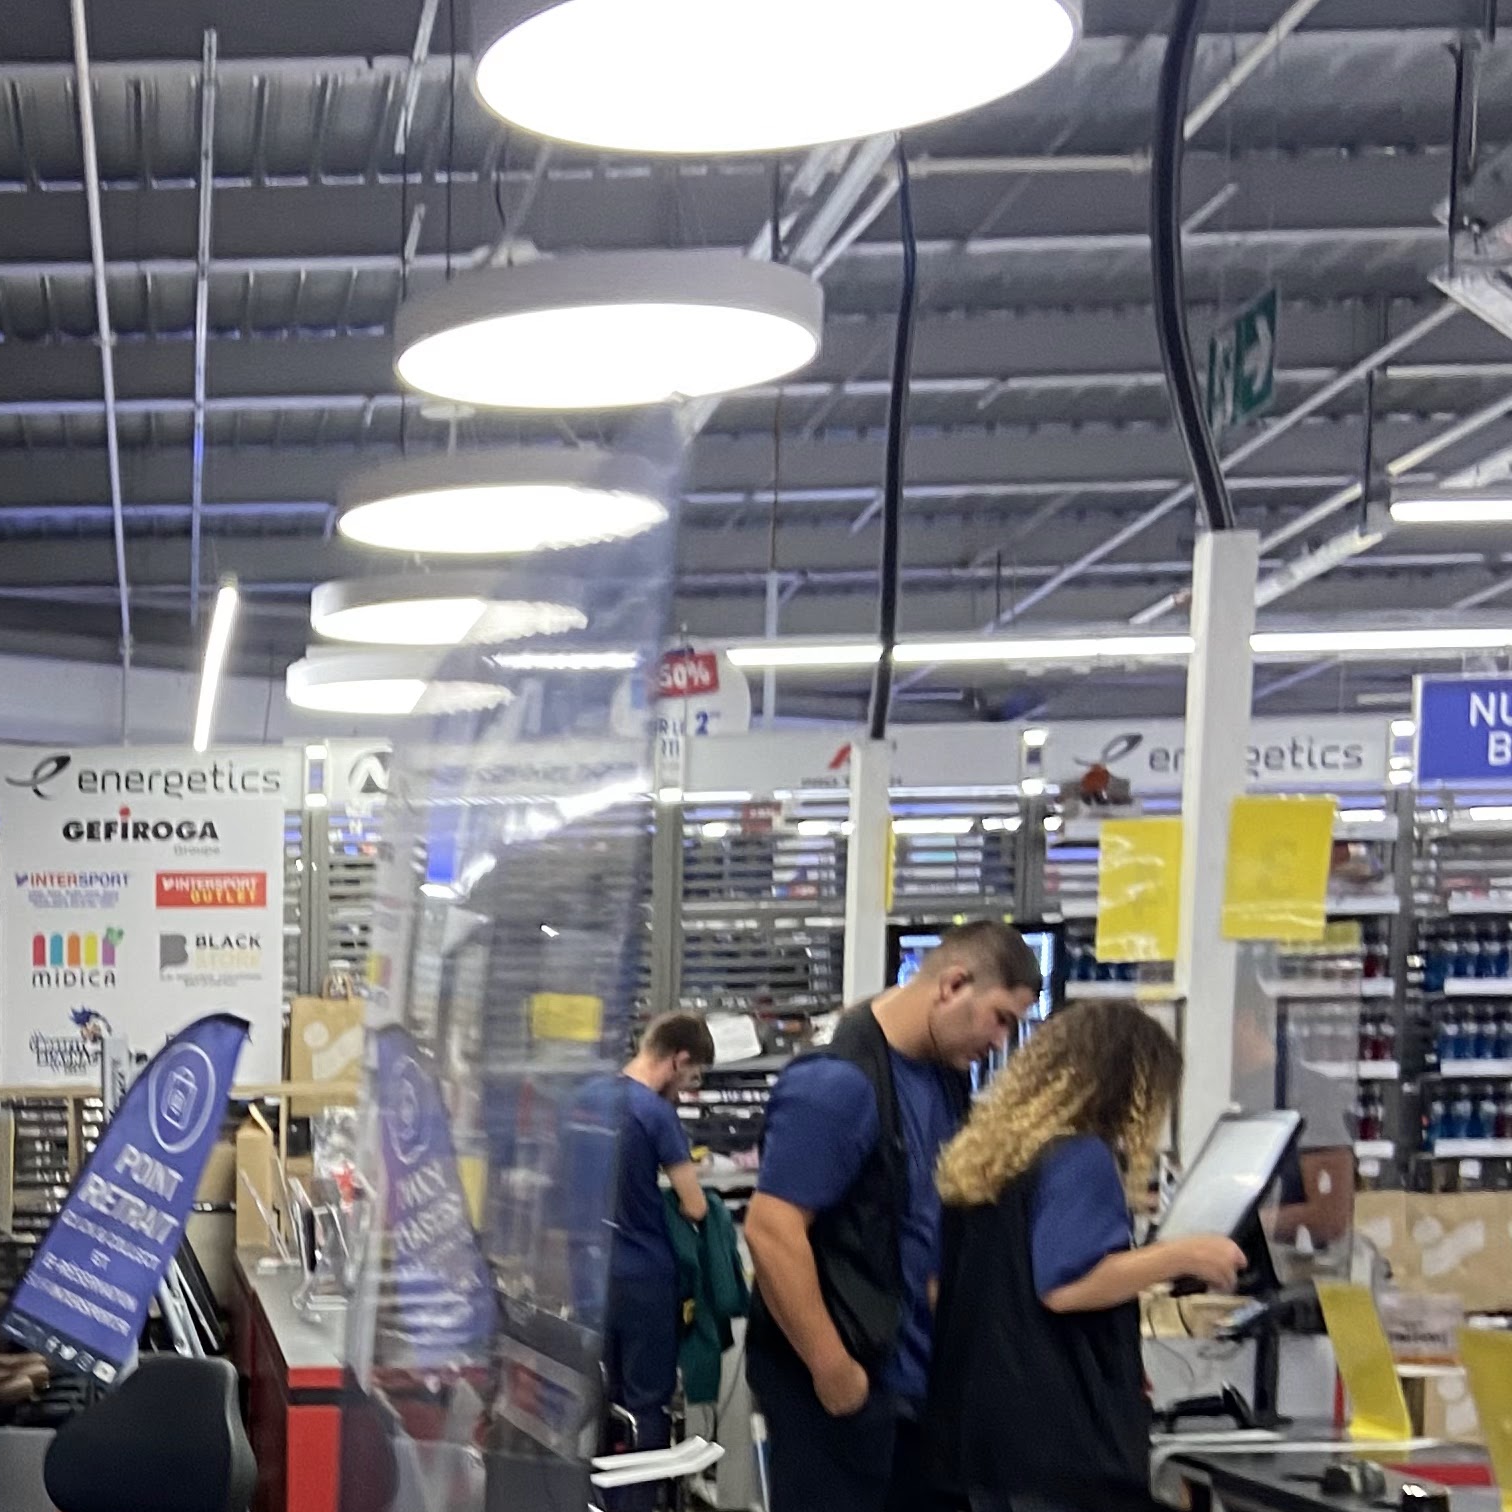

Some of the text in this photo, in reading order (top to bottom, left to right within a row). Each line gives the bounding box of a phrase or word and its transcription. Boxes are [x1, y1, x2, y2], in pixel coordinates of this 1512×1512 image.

[1149, 736, 1364, 778] engetics
[77, 760, 281, 799] energetics
[16, 872, 130, 888] INTERSPORT
[195, 933, 263, 949] BLACK
